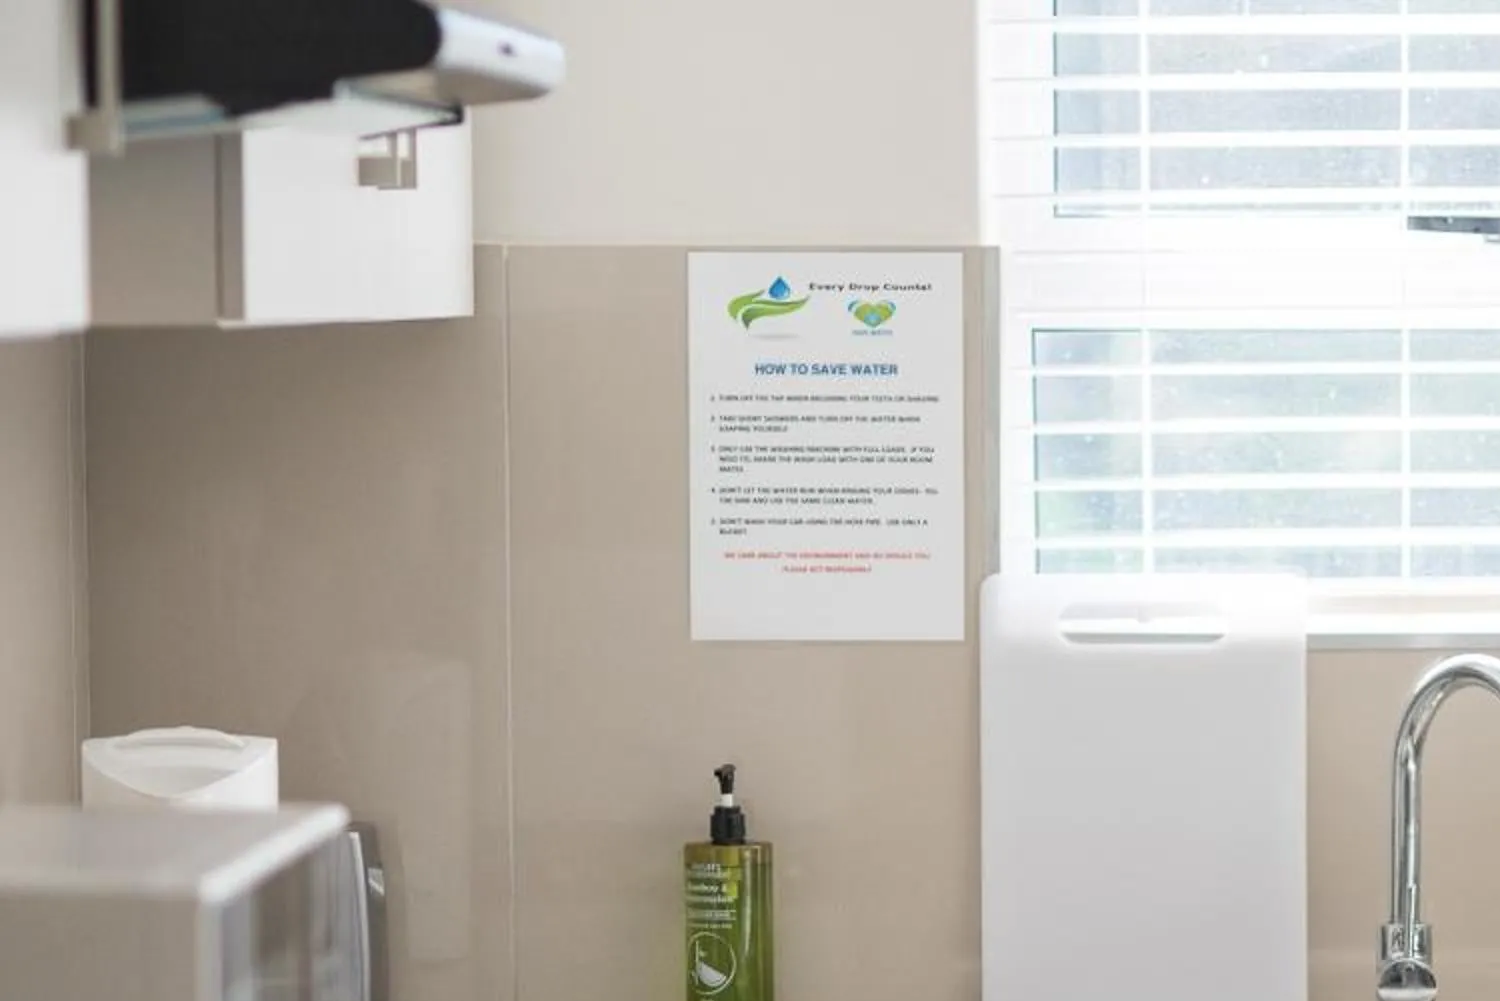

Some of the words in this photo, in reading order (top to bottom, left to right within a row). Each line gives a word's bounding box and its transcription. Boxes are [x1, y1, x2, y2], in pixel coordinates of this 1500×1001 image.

[808, 282, 845, 293] Every
[848, 282, 880, 293] Drop
[754, 363, 787, 376] HOW
[790, 363, 809, 376] TO
[811, 363, 846, 376] SAVE
[851, 363, 899, 376] WATER
